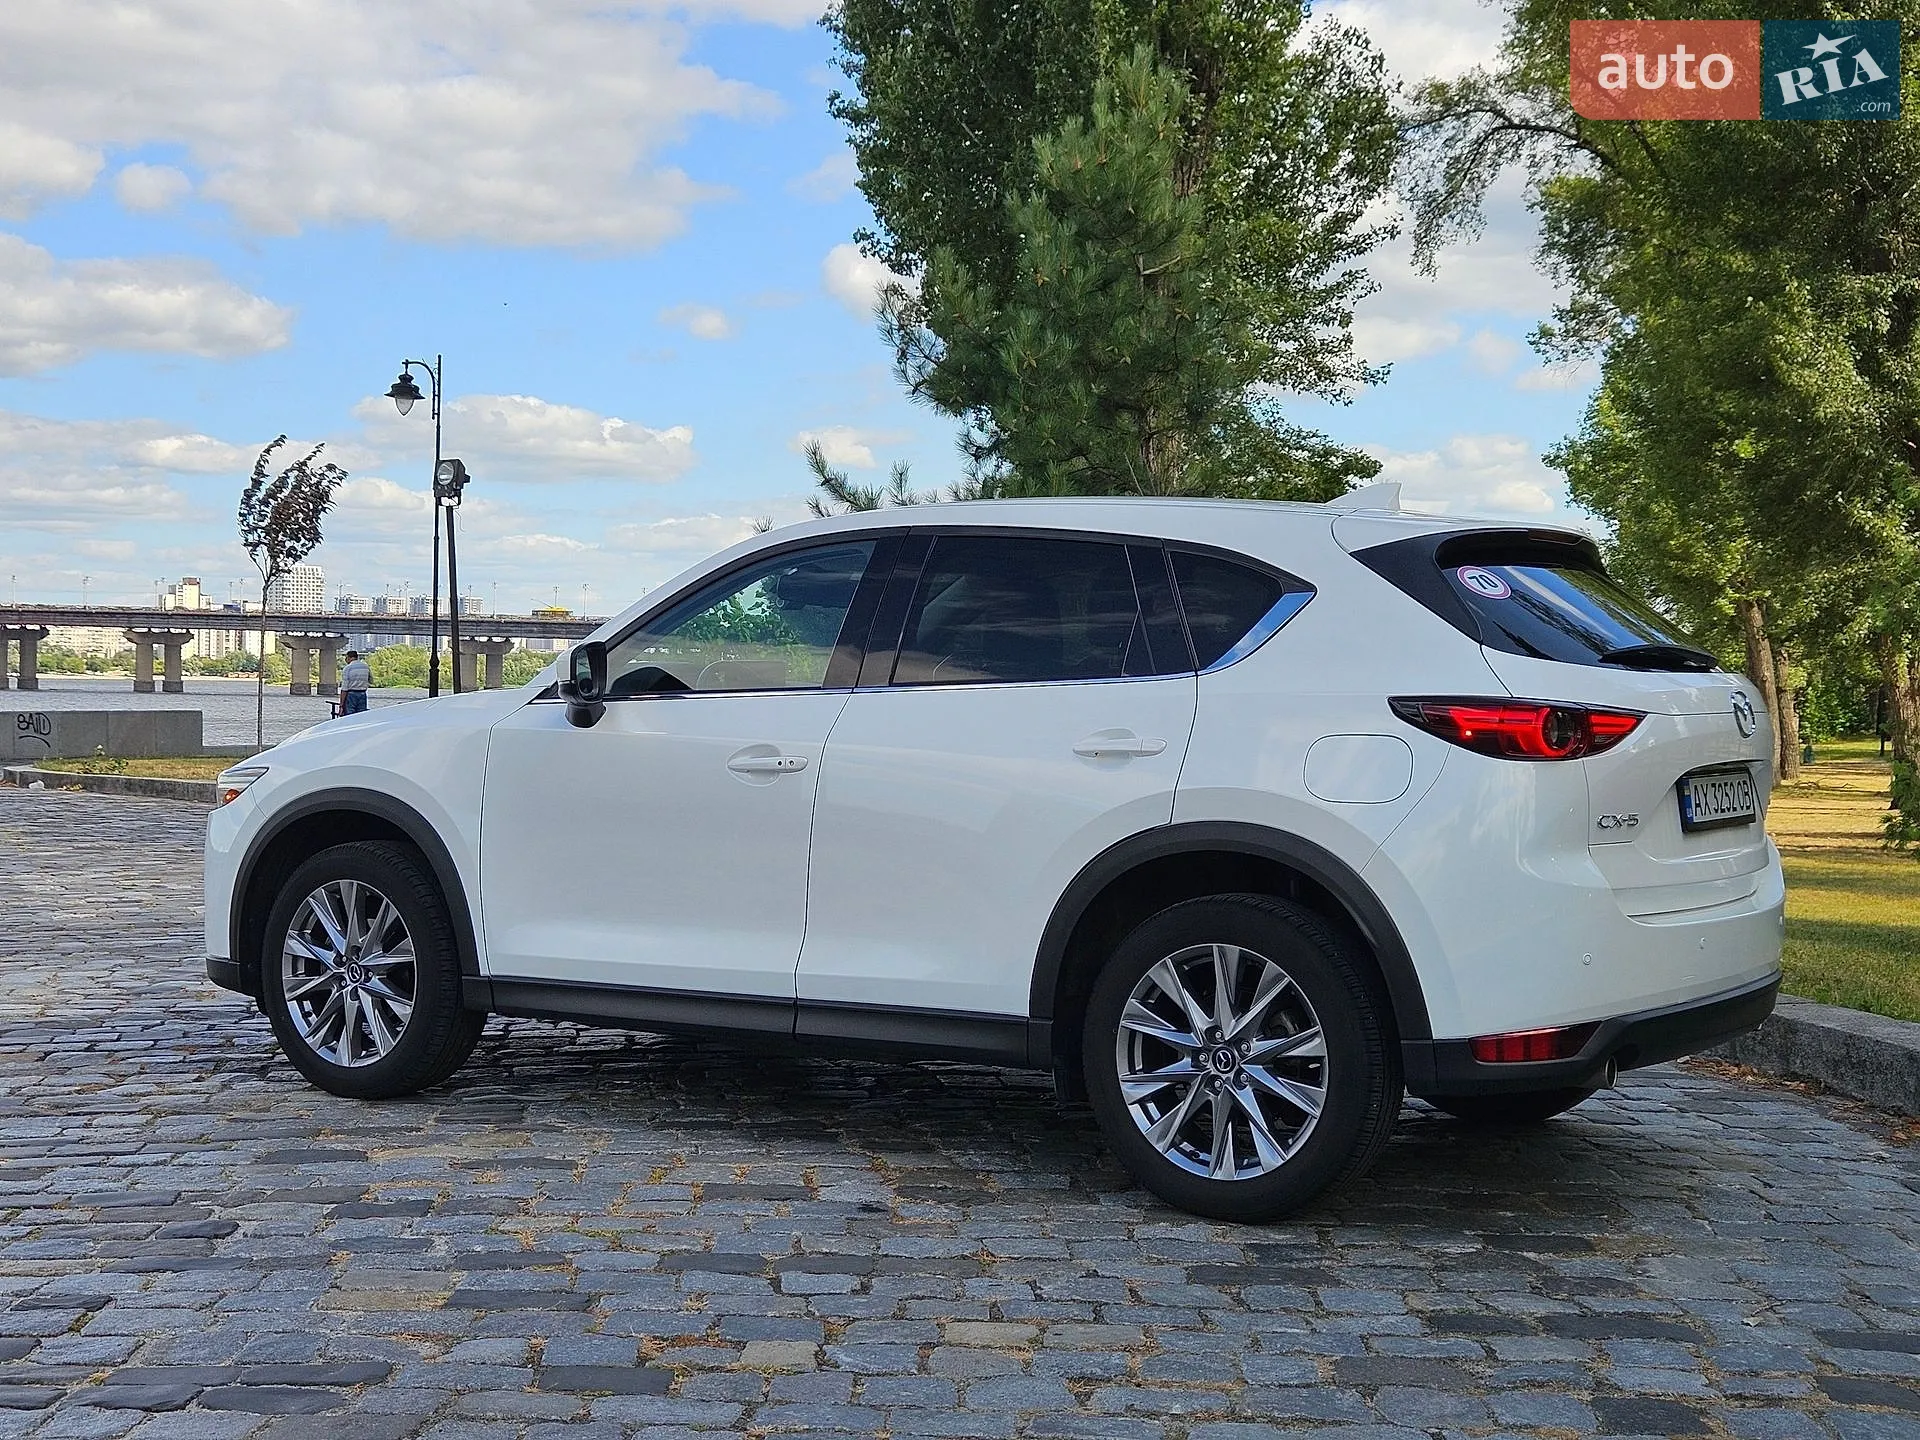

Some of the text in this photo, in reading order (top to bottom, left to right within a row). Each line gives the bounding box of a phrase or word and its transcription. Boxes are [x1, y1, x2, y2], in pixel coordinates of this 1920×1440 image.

[1467, 574, 1499, 590] 70
[1694, 783, 1712, 817] AX
[1711, 781, 1738, 814] 3252
[1597, 812, 1640, 829] CX-5
